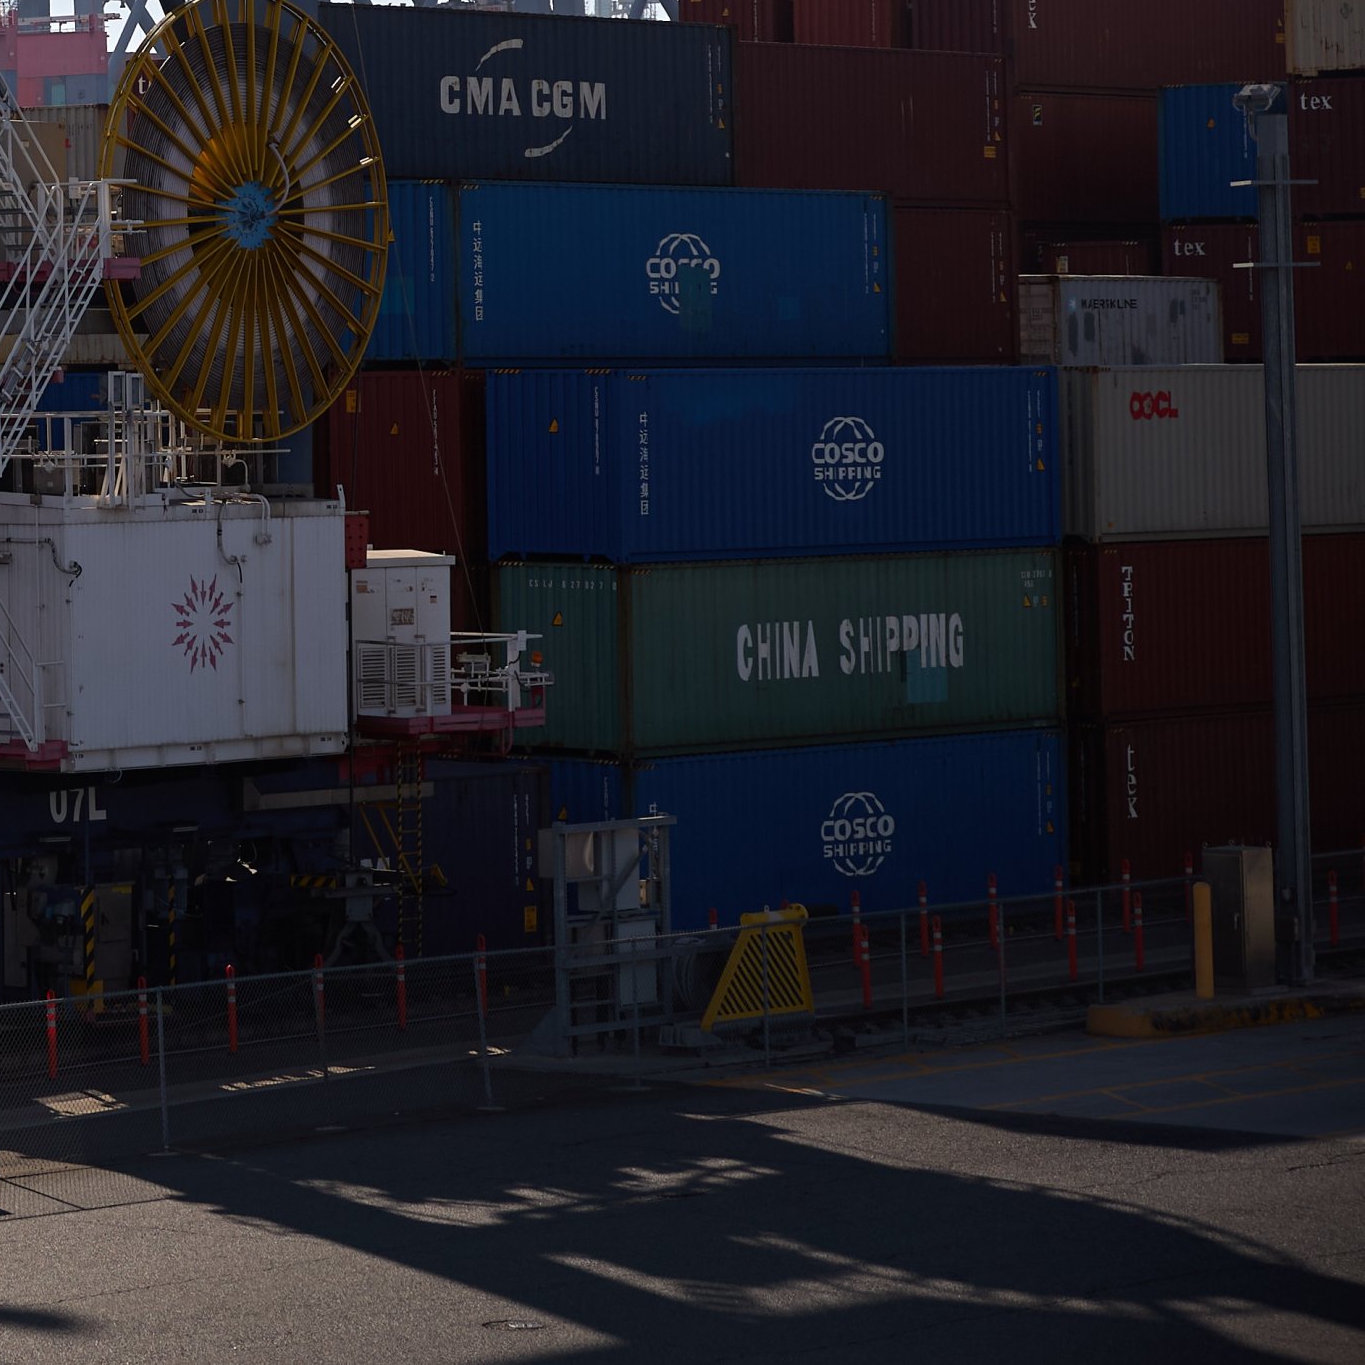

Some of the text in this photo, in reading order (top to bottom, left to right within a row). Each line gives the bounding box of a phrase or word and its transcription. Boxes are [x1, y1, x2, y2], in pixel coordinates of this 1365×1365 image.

[440, 75, 607, 120] CMA CGM
[1301, 93, 1333, 111] tex
[1174, 238, 1206, 256] tex
[646, 257, 720, 279] COO
[1130, 391, 1178, 420] OOCL
[812, 442, 884, 464] COSCO
[814, 466, 881, 480] SHIPPING
[1121, 565, 1135, 661] TRITON
[737, 611, 964, 682] CHINA SHIPPING
[1127, 743, 1138, 818] tex
[820, 819, 894, 842] COSCO
[824, 840, 892, 857] SHIPPING
